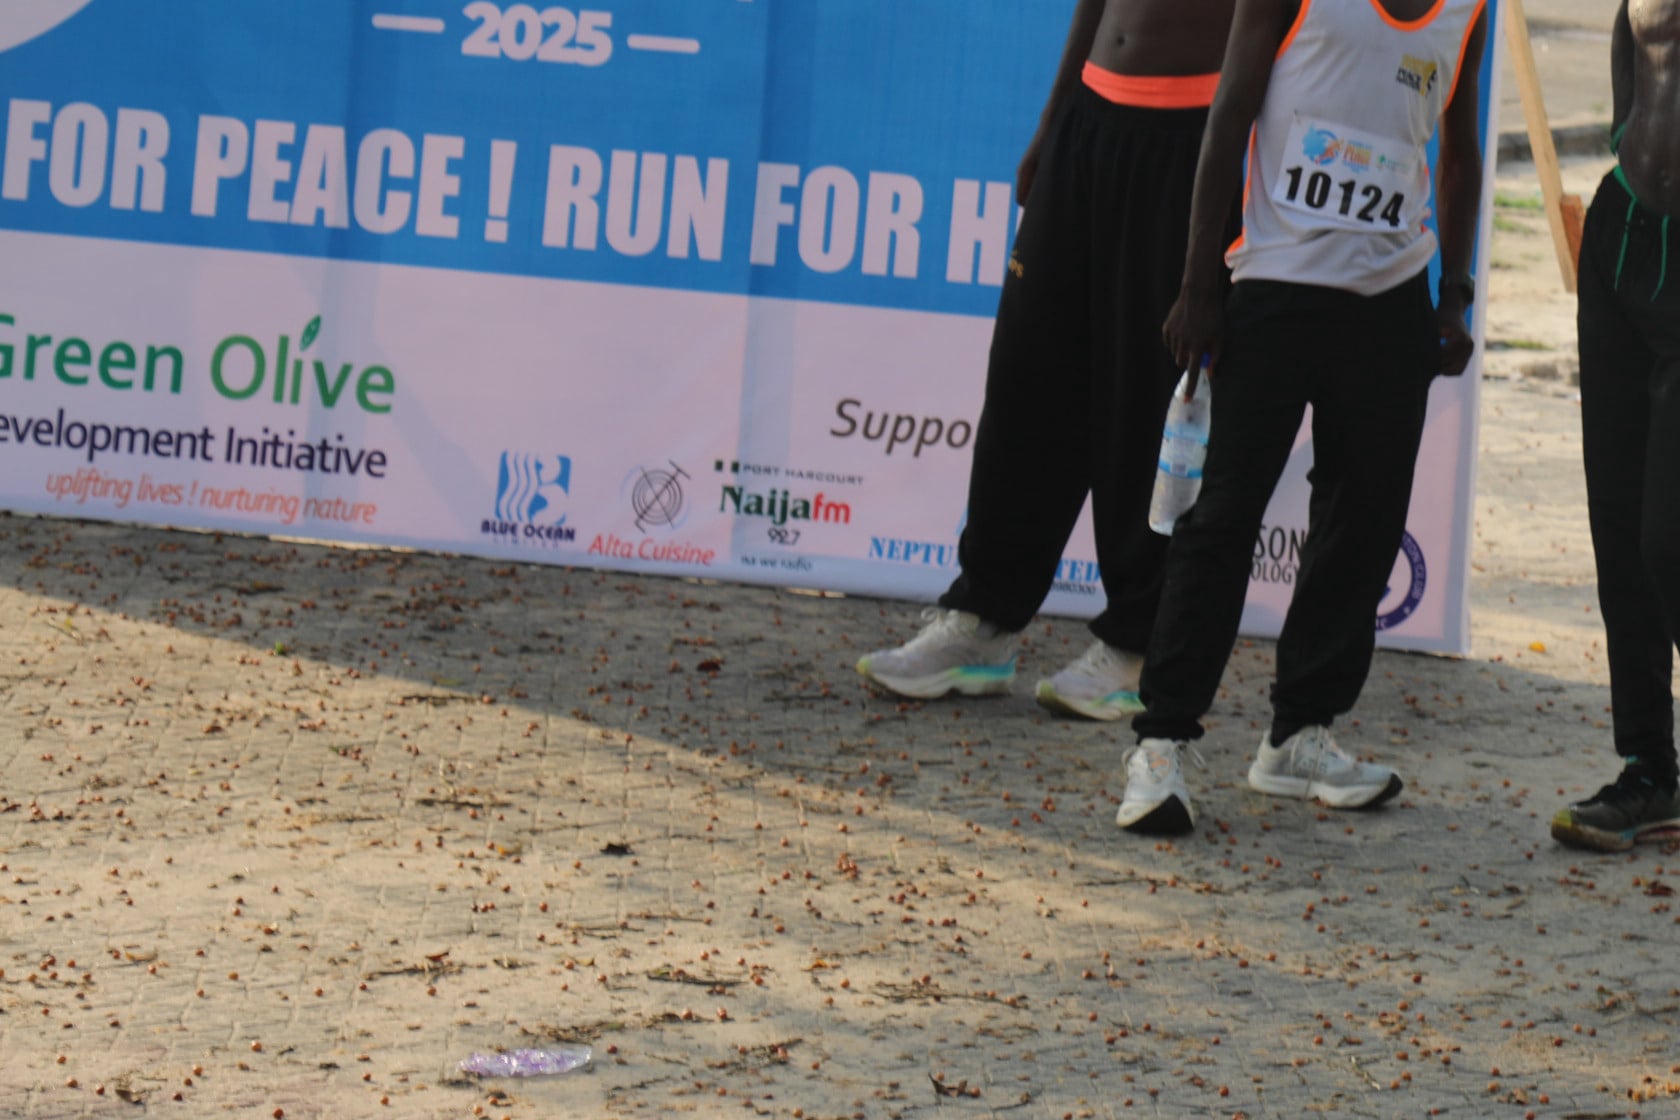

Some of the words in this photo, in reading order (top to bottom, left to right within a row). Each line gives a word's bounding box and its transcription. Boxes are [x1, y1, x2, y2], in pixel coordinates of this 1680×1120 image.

[461, 1, 613, 66] 2025
[2, 98, 171, 213] FOR
[191, 113, 466, 240] PEACE
[484, 139, 518, 244] !
[541, 143, 729, 262] RUN
[749, 161, 924, 280] FOR
[1286, 165, 1404, 227] 10124
[210, 315, 396, 414] Olive
[225, 427, 388, 478] Initiative
[46, 467, 133, 509] uplifting
[137, 473, 184, 506] lives
[201, 483, 300, 525] nurturing
[303, 496, 378, 525] nature
[719, 484, 852, 526] Naijafm
[481, 519, 518, 537] BLUE
[524, 523, 576, 542] OCEAN
[587, 532, 634, 559] Alta
[638, 536, 716, 567] Cuisine
[868, 535, 961, 569] NEPTU
